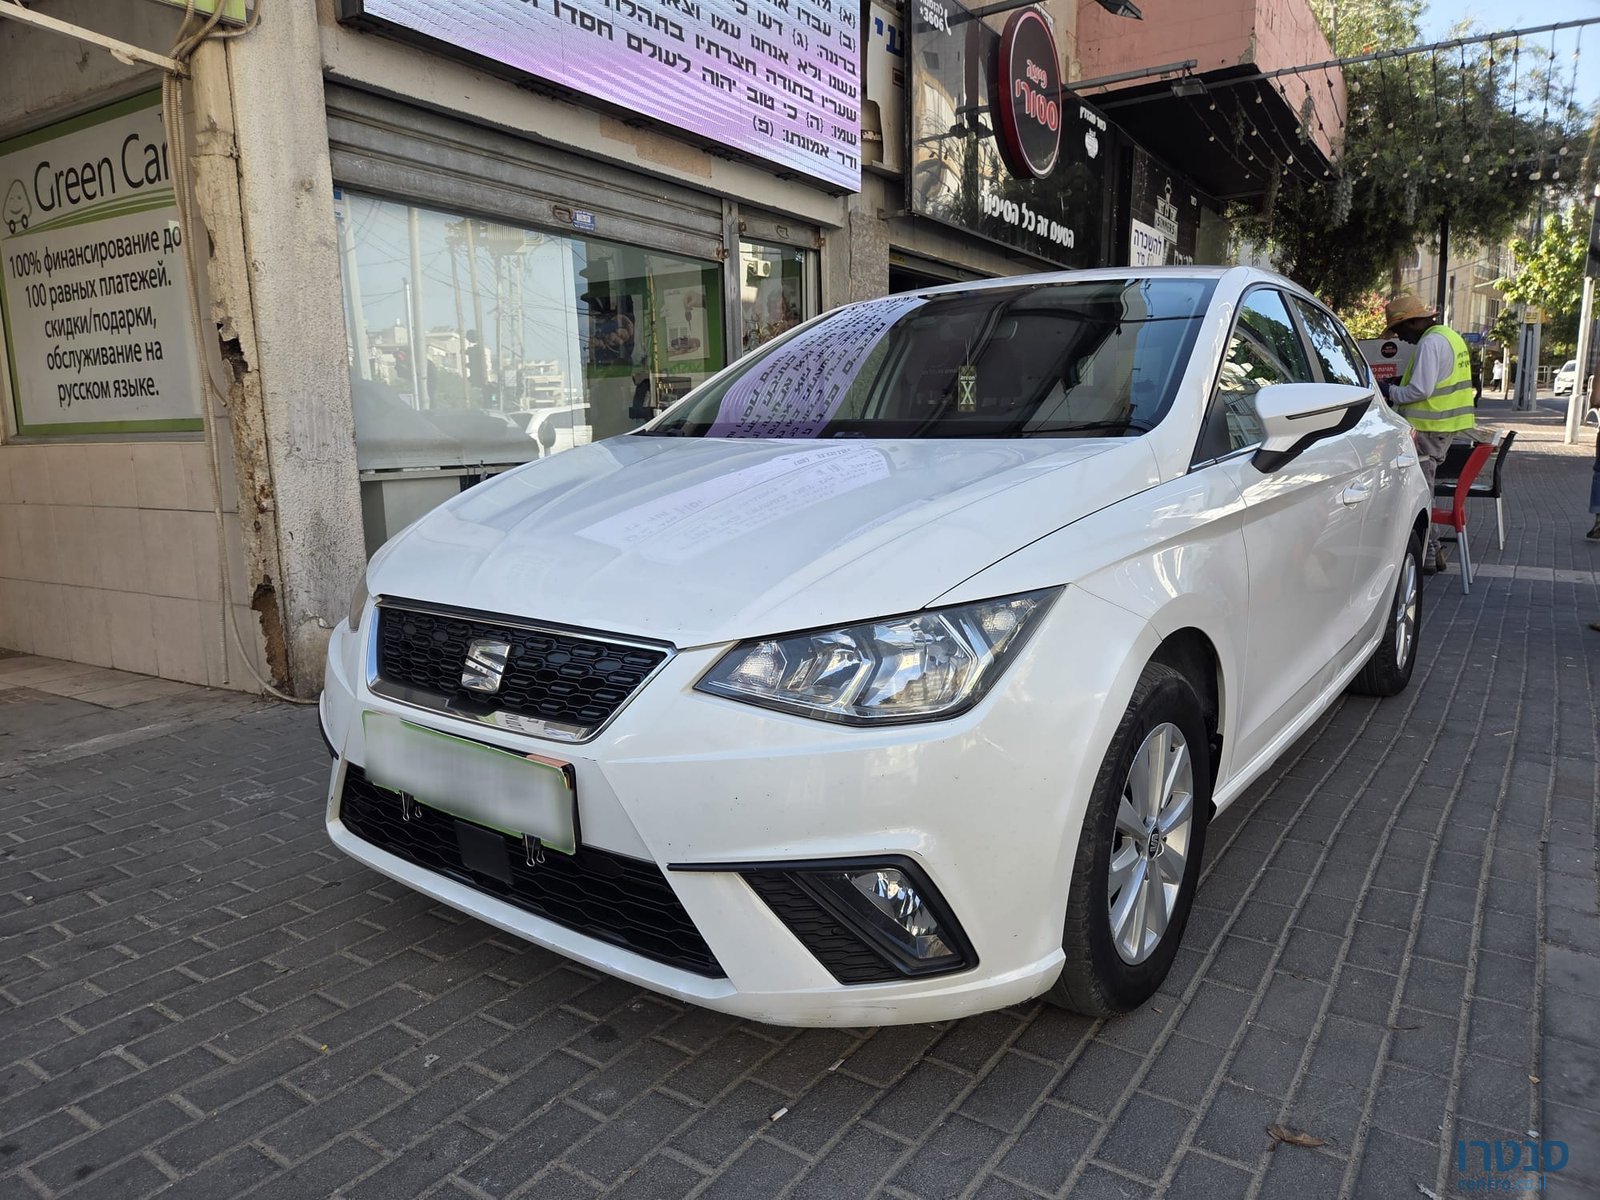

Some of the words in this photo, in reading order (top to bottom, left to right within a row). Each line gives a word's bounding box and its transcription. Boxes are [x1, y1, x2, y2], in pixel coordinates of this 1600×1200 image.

[553, 0, 614, 42] חסדו
[660, 0, 700, 20] וצא
[731, 0, 747, 16] כ
[757, 10, 784, 36] דעו
[797, 7, 831, 37] עבדו
[710, 13, 742, 40] עמו
[626, 32, 692, 74] לעולם
[695, 34, 757, 77] חצרתיו
[750, 34, 789, 65] אנחנו
[816, 44, 857, 76] ברננה:
[701, 66, 737, 92] יהוה
[797, 57, 822, 82] ולא
[746, 86, 776, 111] טוב
[766, 68, 815, 104] בתודה
[828, 74, 858, 99] עשנו
[783, 103, 798, 121] כי
[821, 95, 858, 123] שעריו
[1015, 79, 1059, 131] סטורי
[782, 128, 830, 159] אמונתו:
[821, 125, 858, 147] שמו:
[34, 153, 116, 212] Green
[121, 133, 170, 189] Car
[836, 150, 858, 170] ודר
[1021, 202, 1036, 232] כל
[1037, 215, 1049, 238] זה
[10, 249, 42, 279] 100%
[43, 233, 160, 278] финансирование
[163, 226, 182, 252] до
[1133, 229, 1162, 256] להשכרה
[25, 283, 47, 308] 100
[49, 277, 98, 310] равных
[99, 263, 172, 297] платежей.
[45, 303, 157, 339] скидки/подарки,
[46, 342, 143, 374] обслуживание
[145, 340, 163, 361] на
[57, 379, 110, 408] русском
[113, 375, 160, 398] языке.
